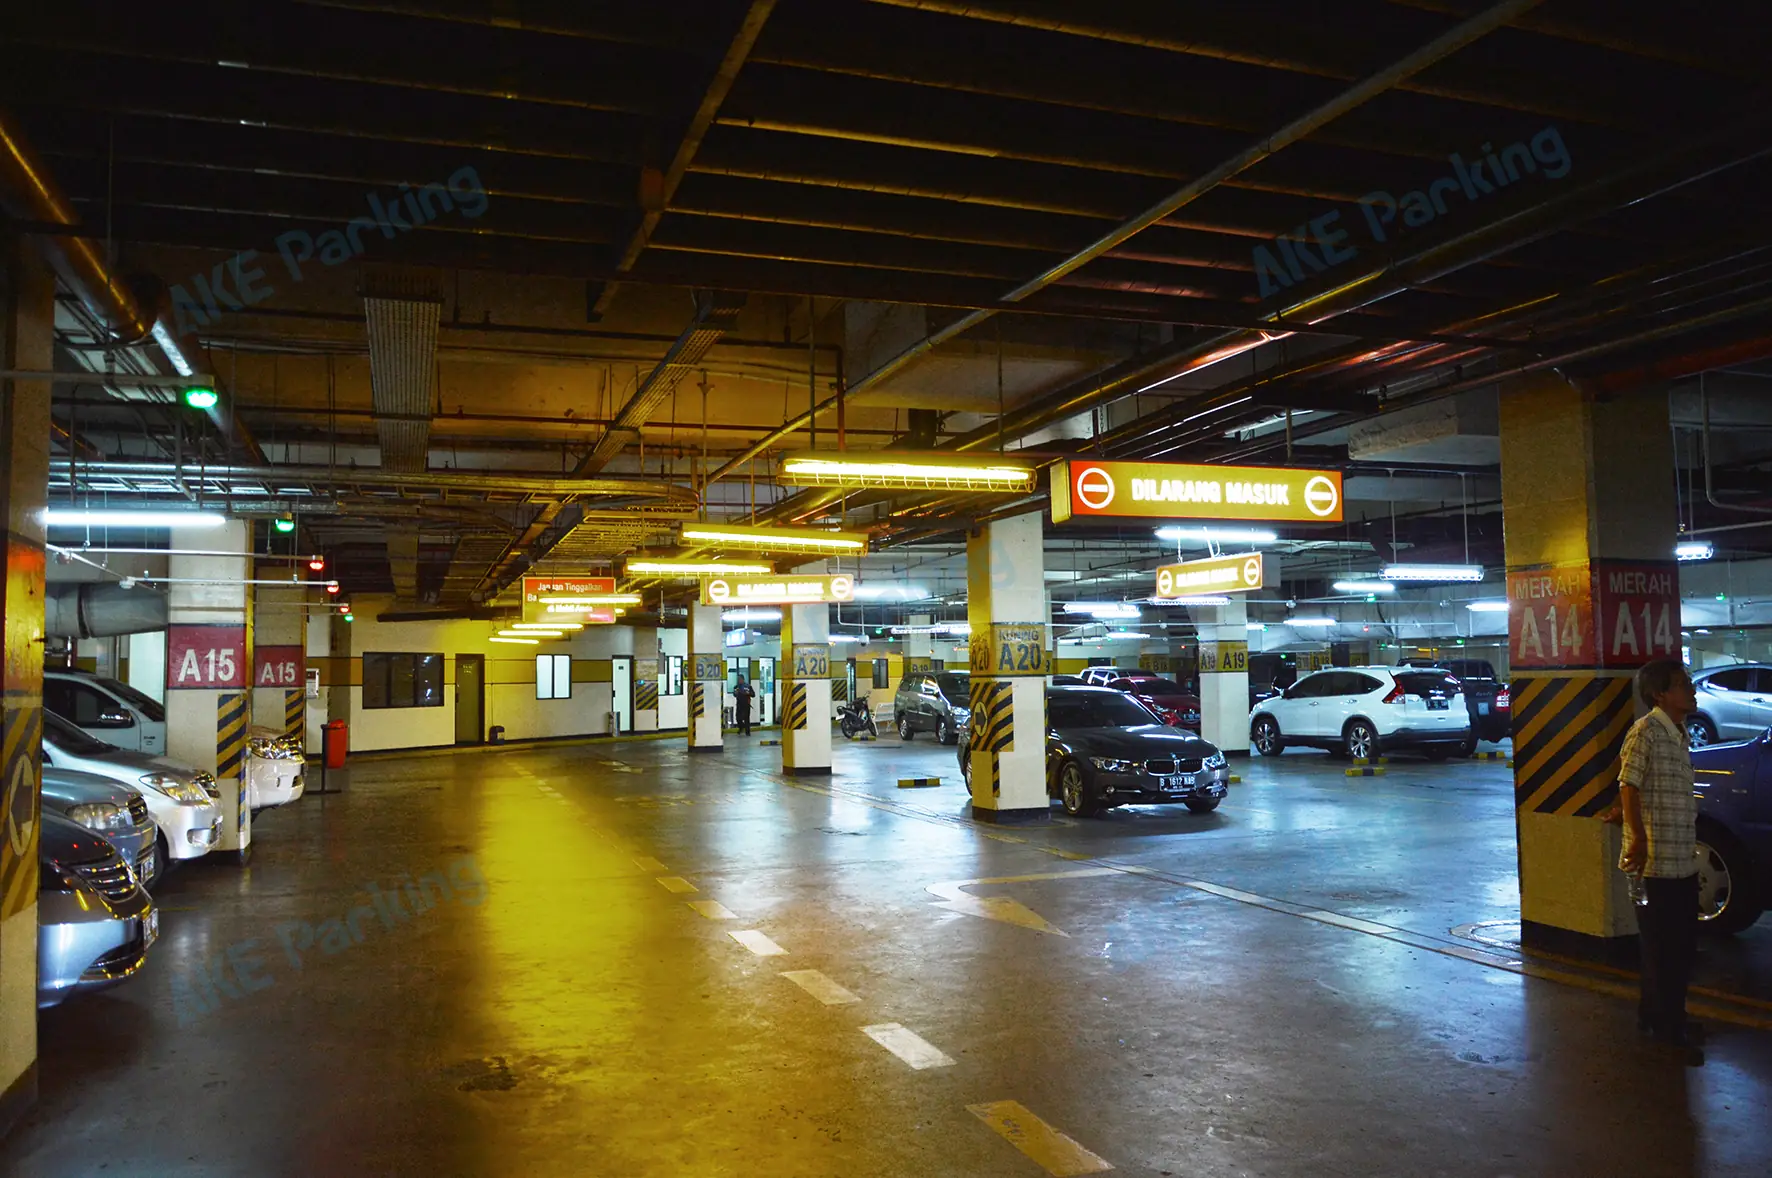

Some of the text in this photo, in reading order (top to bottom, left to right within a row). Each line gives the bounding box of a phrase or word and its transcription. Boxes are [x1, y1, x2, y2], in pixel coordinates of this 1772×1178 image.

[1131, 478, 1289, 505] DILARANG MASUK
[1515, 574, 1580, 600] MERAH
[1609, 572, 1672, 595] MERAH
[1518, 603, 1582, 659] A14
[1612, 601, 1674, 655] A14
[178, 648, 236, 682] A15
[797, 657, 827, 675] A20
[999, 643, 1042, 671] A20
[1222, 651, 1245, 669] A19
[260, 662, 296, 683] A15
